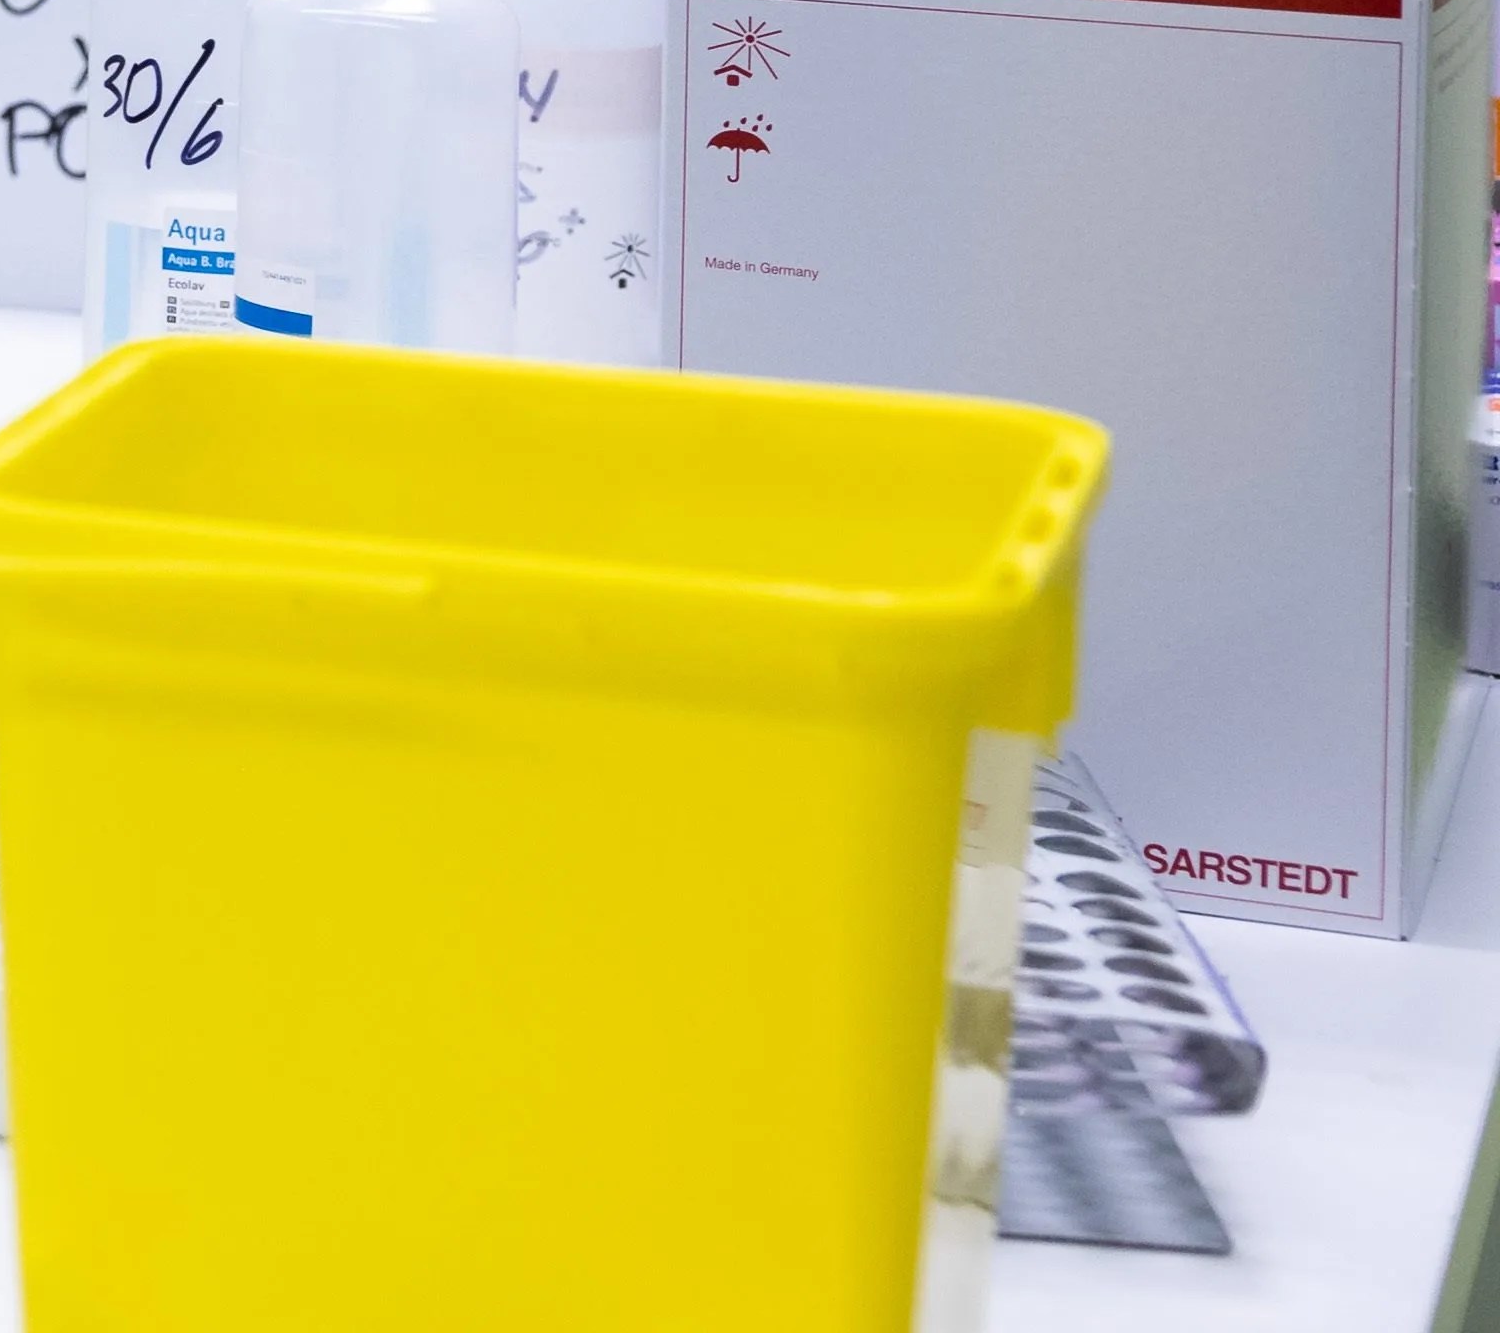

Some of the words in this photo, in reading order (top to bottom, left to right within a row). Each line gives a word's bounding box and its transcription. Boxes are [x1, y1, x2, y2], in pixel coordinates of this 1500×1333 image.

[102, 38, 225, 170] 30/6
[168, 218, 226, 246] Aqua
[168, 252, 198, 267] Aqua
[201, 255, 212, 267] B.
[704, 256, 741, 271] Made
[745, 261, 756, 272] in
[760, 262, 819, 281] Germany
[167, 277, 205, 291] Ecolav
[1143, 843, 1359, 899] SARSTEDT
